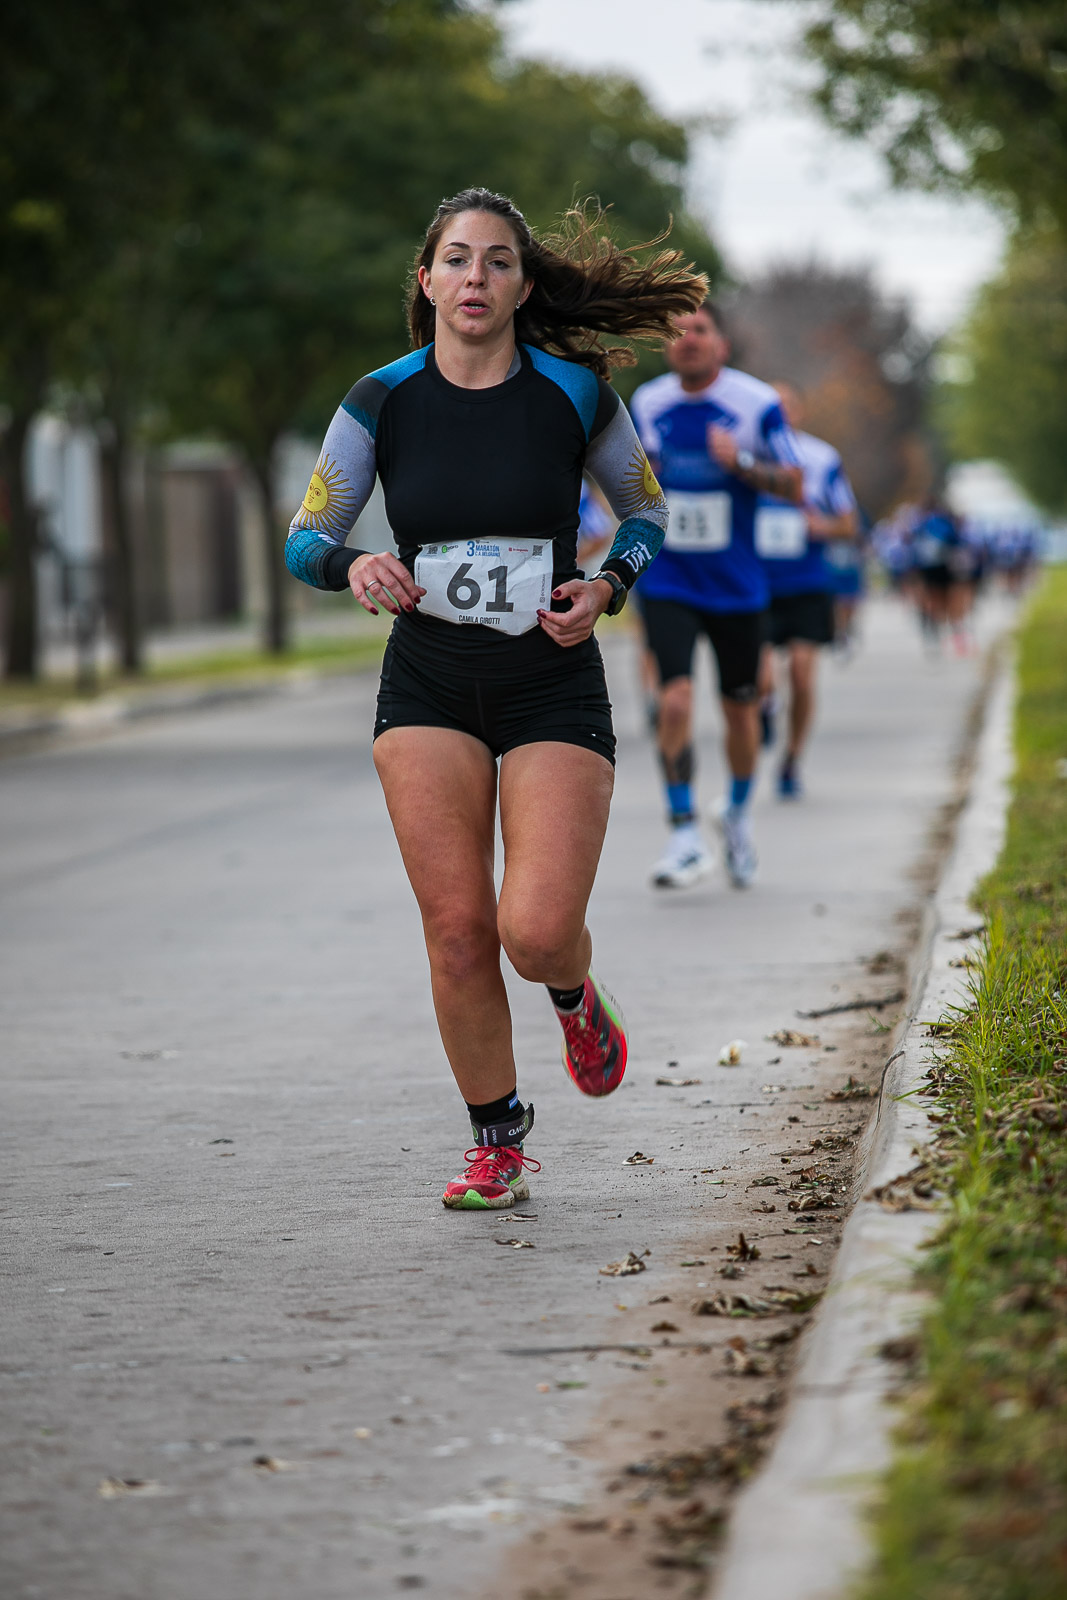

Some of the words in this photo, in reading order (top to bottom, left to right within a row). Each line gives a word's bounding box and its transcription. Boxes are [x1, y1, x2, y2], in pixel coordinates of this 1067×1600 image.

[467, 541, 475, 557] 3
[447, 563, 514, 612] 61
[459, 615, 478, 624] CAMILA
[480, 617, 501, 625] GIROTTI
